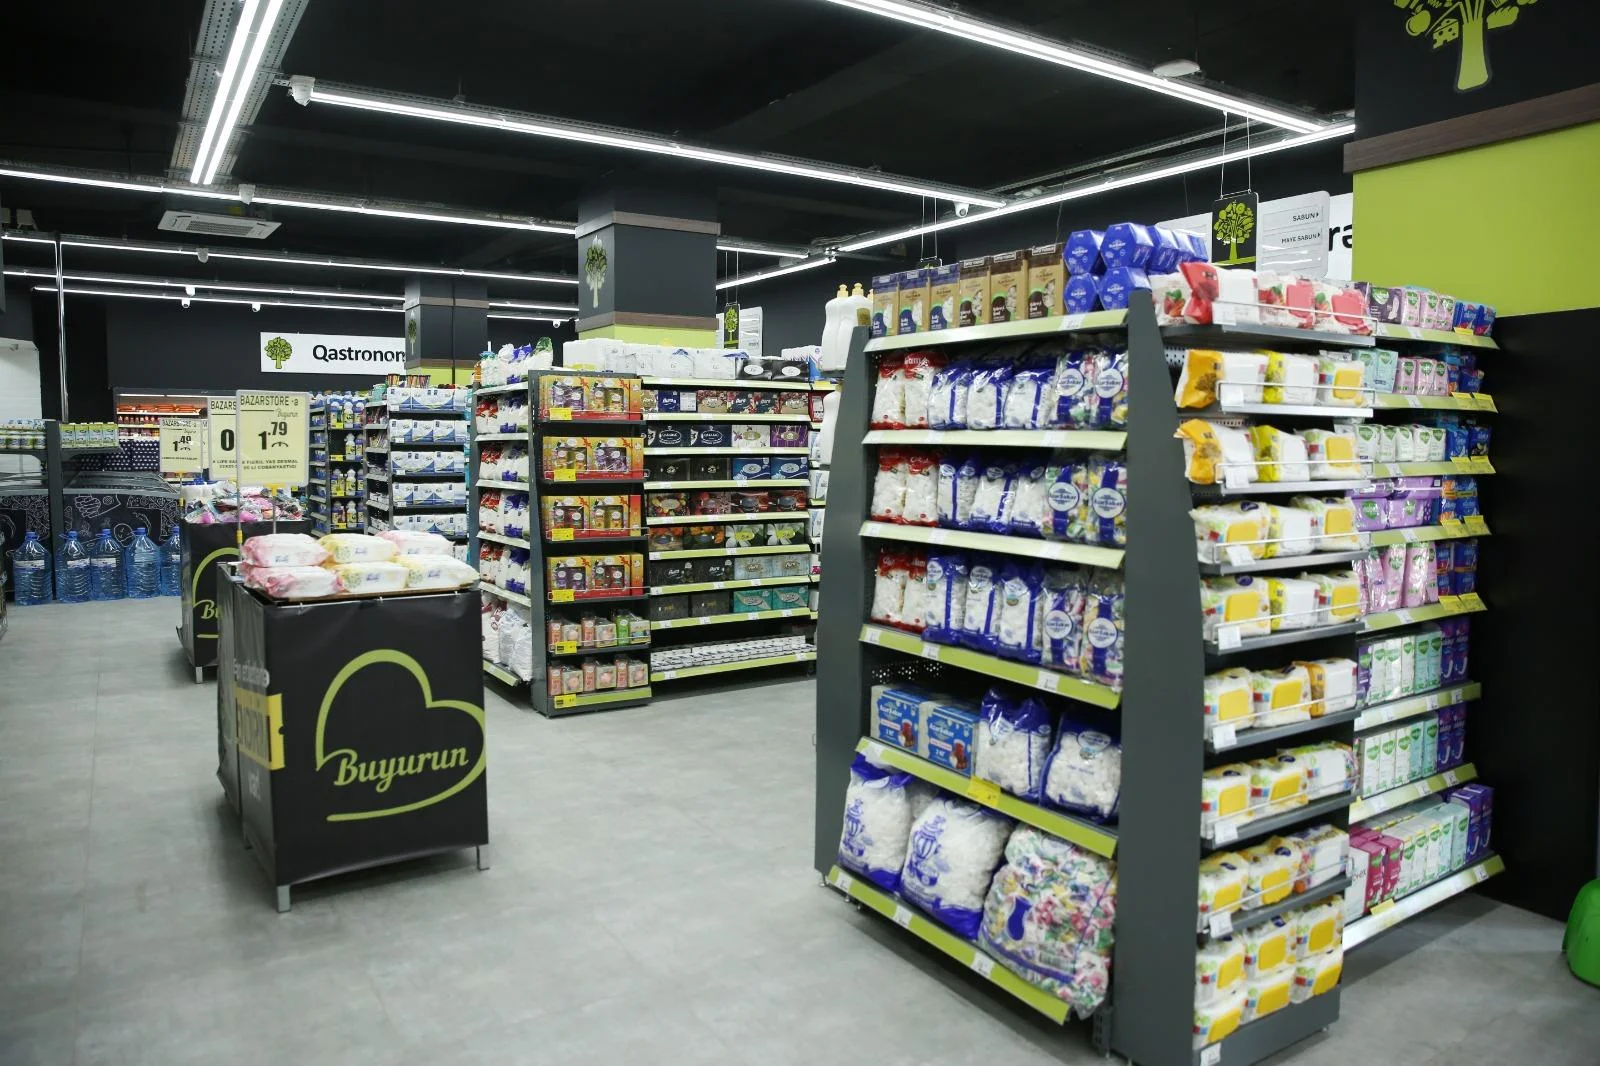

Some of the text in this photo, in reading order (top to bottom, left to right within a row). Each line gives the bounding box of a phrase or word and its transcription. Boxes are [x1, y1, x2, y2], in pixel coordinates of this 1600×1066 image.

[1293, 213, 1315, 222] SABUN
[1297, 234, 1317, 242] SABUN
[240, 395, 290, 406] BAZARSTORE
[333, 747, 470, 793] Buyurun
